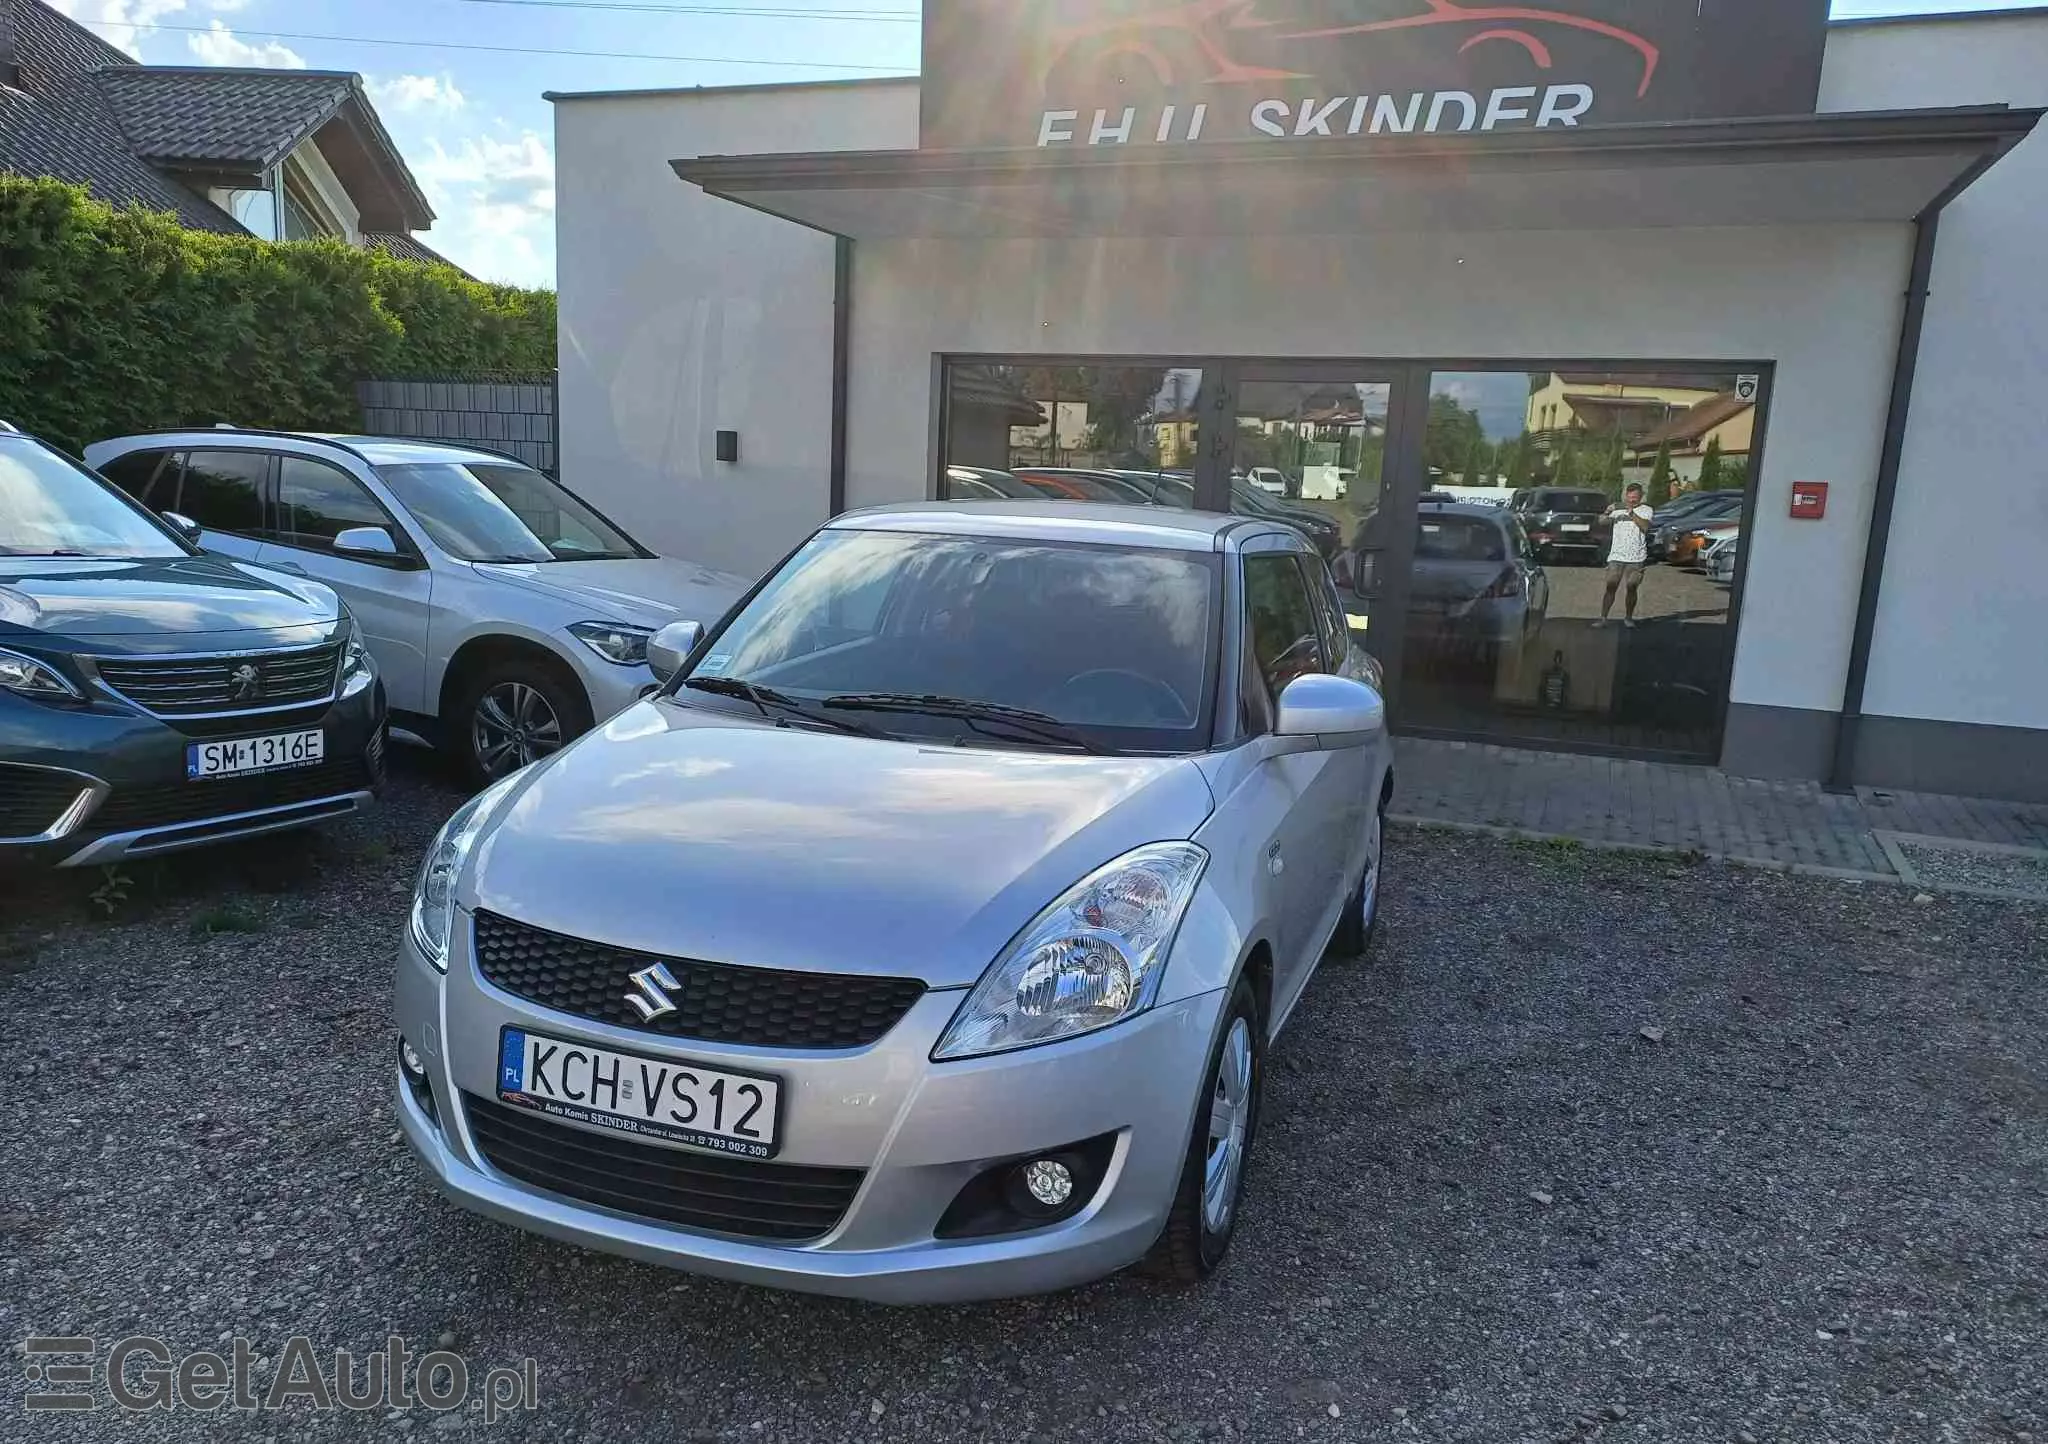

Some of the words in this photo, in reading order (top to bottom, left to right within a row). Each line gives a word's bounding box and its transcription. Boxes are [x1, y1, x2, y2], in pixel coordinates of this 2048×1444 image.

[204, 743, 238, 771] SM
[249, 732, 318, 766] 1316E
[505, 1067, 521, 1084] PL
[530, 1041, 620, 1110] KCH
[640, 1064, 760, 1138] VS12
[545, 1103, 563, 1114] Auto
[591, 1112, 638, 1132] SKINDER
[708, 1138, 725, 1149] 793
[728, 1141, 747, 1153] 002
[749, 1145, 768, 1157] 309
